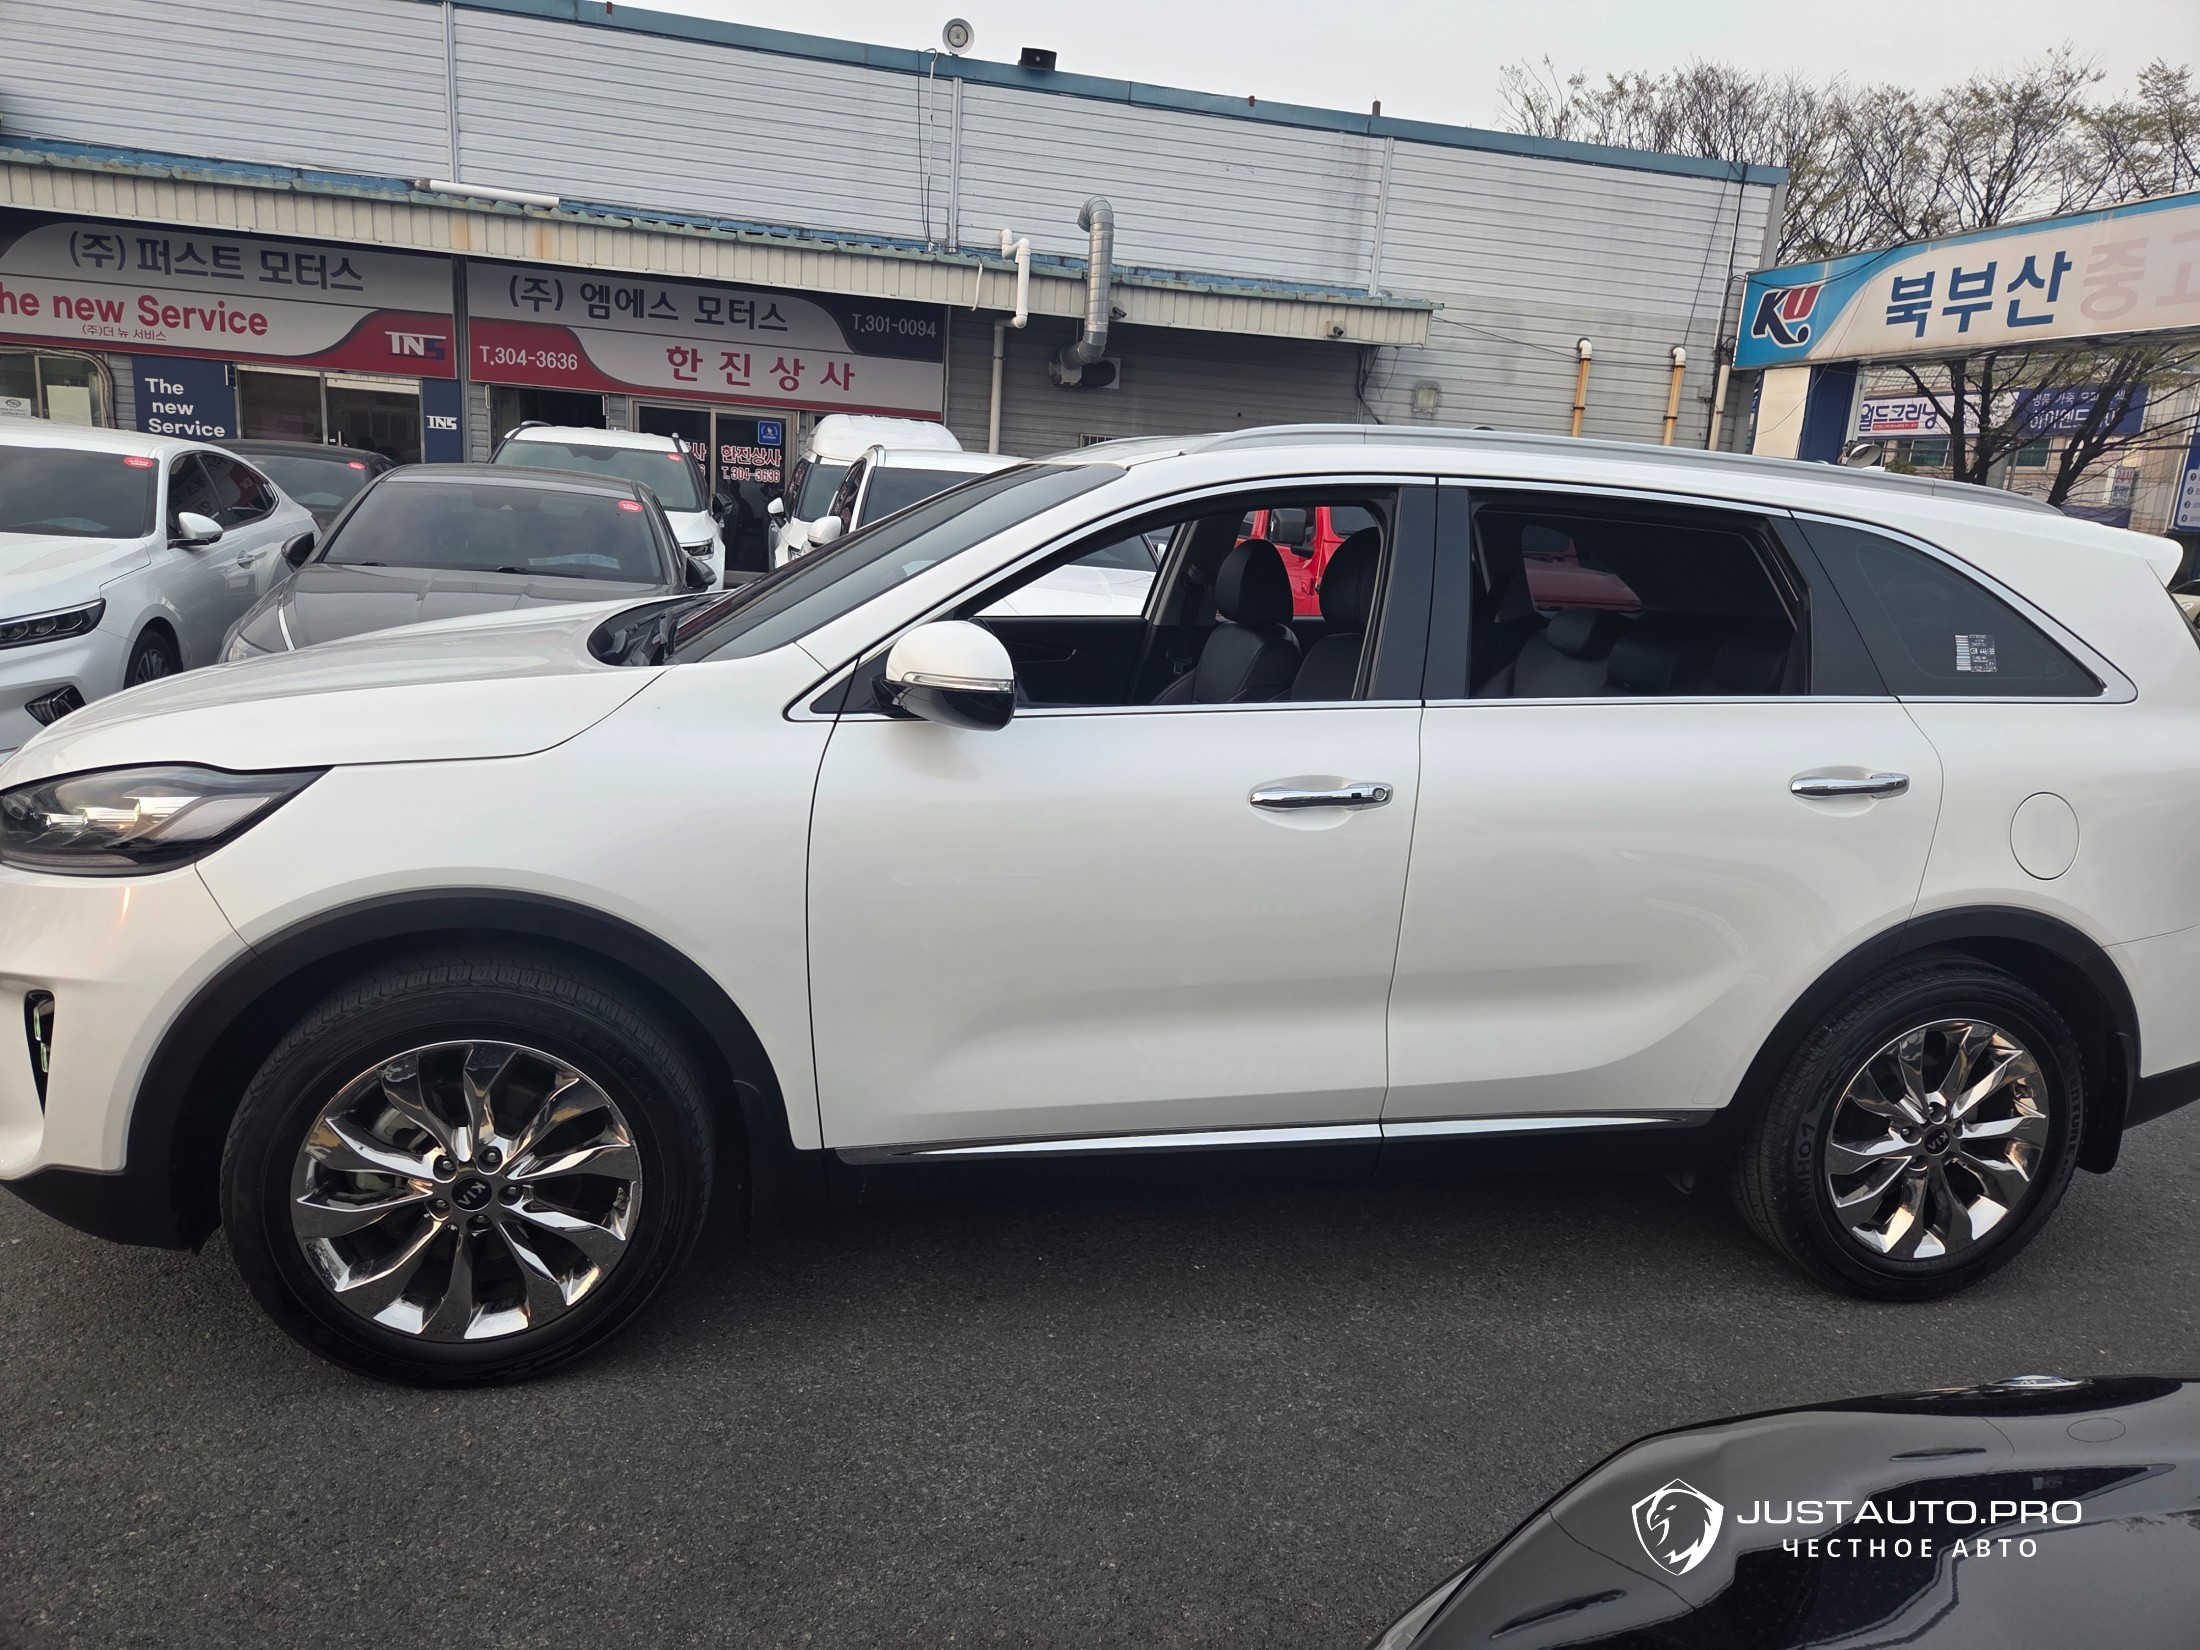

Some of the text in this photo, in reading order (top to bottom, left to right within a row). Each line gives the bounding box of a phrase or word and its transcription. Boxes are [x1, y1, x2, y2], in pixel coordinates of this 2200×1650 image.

[69, 231, 364, 291] (주) 퍼스트 모터스
[509, 275, 789, 332] (주) 엠에스 모터스
[1886, 251, 2073, 338] 북부산
[53, 295, 125, 324] new
[137, 294, 268, 336] Service
[852, 313, 937, 337] T.301-0094
[132, 329, 167, 342] 서비스
[479, 345, 578, 371] T.304-3636
[144, 377, 185, 396] The
[152, 401, 194, 416] new
[148, 418, 226, 437] Service
[721, 445, 782, 467] 한진상사
[721, 466, 780, 483] T.304-3636
[1927, 1131, 1949, 1150] KIA
[458, 1181, 487, 1205] KIA
